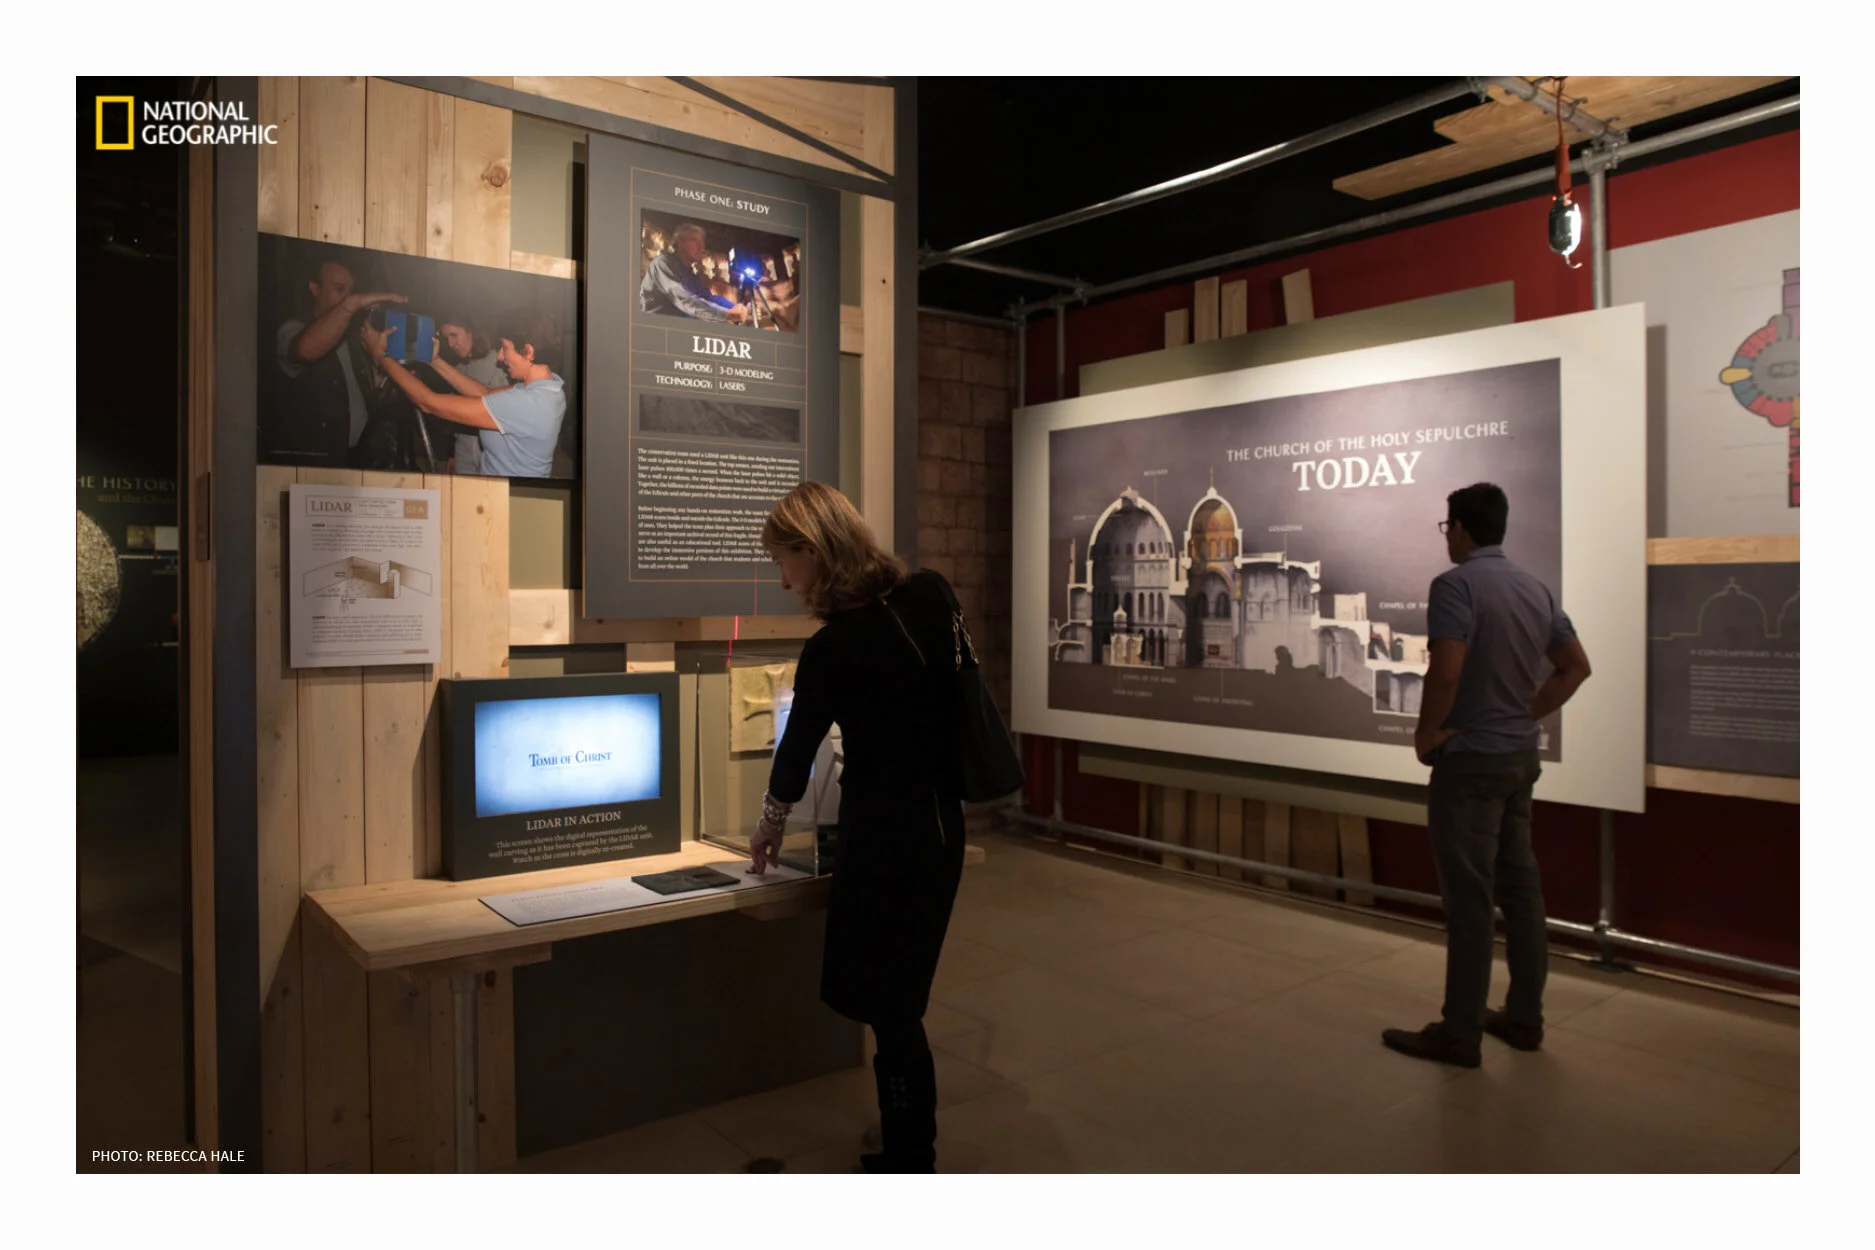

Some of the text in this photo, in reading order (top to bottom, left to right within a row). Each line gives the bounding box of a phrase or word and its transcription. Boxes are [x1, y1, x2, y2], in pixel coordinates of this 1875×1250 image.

[674, 186, 706, 202] PHASE
[736, 199, 770, 216] STUDY
[692, 335, 752, 360] LIDAR
[674, 360, 774, 380] PURPOSE: 3-D MODELING
[655, 375, 746, 392] TECHNOLOGY: LASERS
[1226, 420, 1509, 462] THE CHURCH OF THE HOLY SEPULCHRE
[76, 475, 177, 491] HE HISTORY
[1292, 451, 1422, 492] TODAY
[311, 501, 352, 513] LIDAR
[527, 810, 621, 831] LIDAR IN ACTION
[488, 849, 503, 859] wall
[608, 836, 619, 844] the
[619, 833, 639, 843] LIDAR
[496, 840, 510, 849] This
[631, 824, 637, 832] of
[638, 824, 648, 832] the
